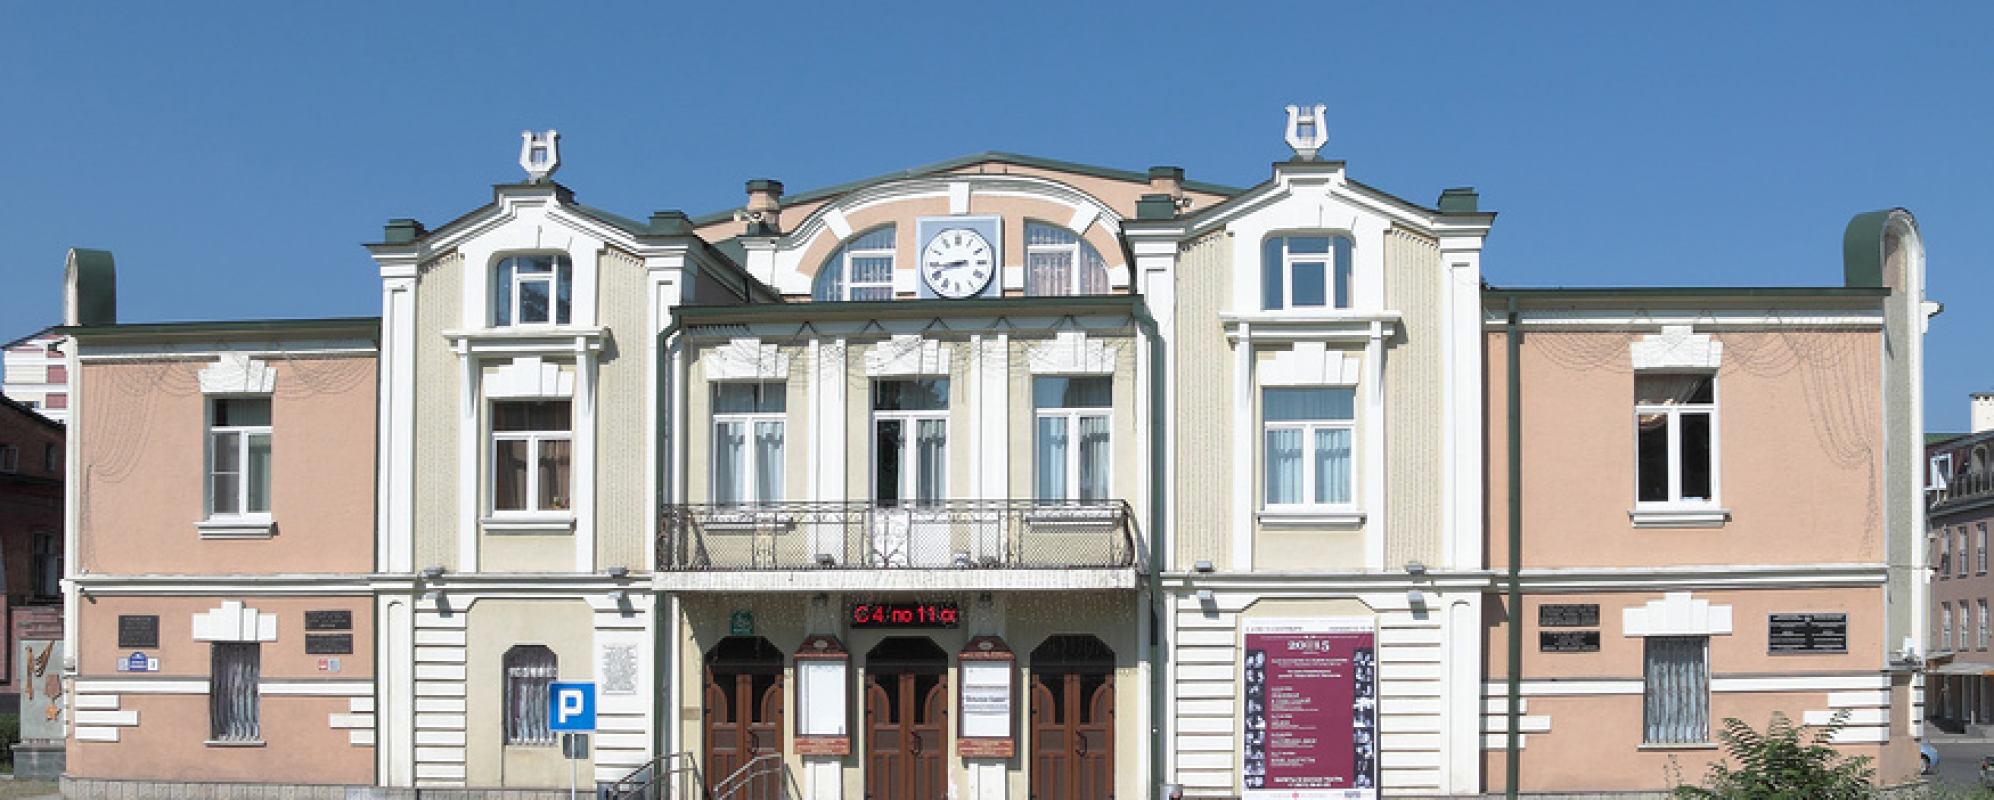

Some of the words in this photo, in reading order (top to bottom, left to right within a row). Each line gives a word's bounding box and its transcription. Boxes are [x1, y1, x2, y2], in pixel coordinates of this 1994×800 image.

[854, 604, 869, 623] С
[872, 604, 883, 623] 4
[917, 605, 936, 623] 11
[558, 689, 584, 723] P
